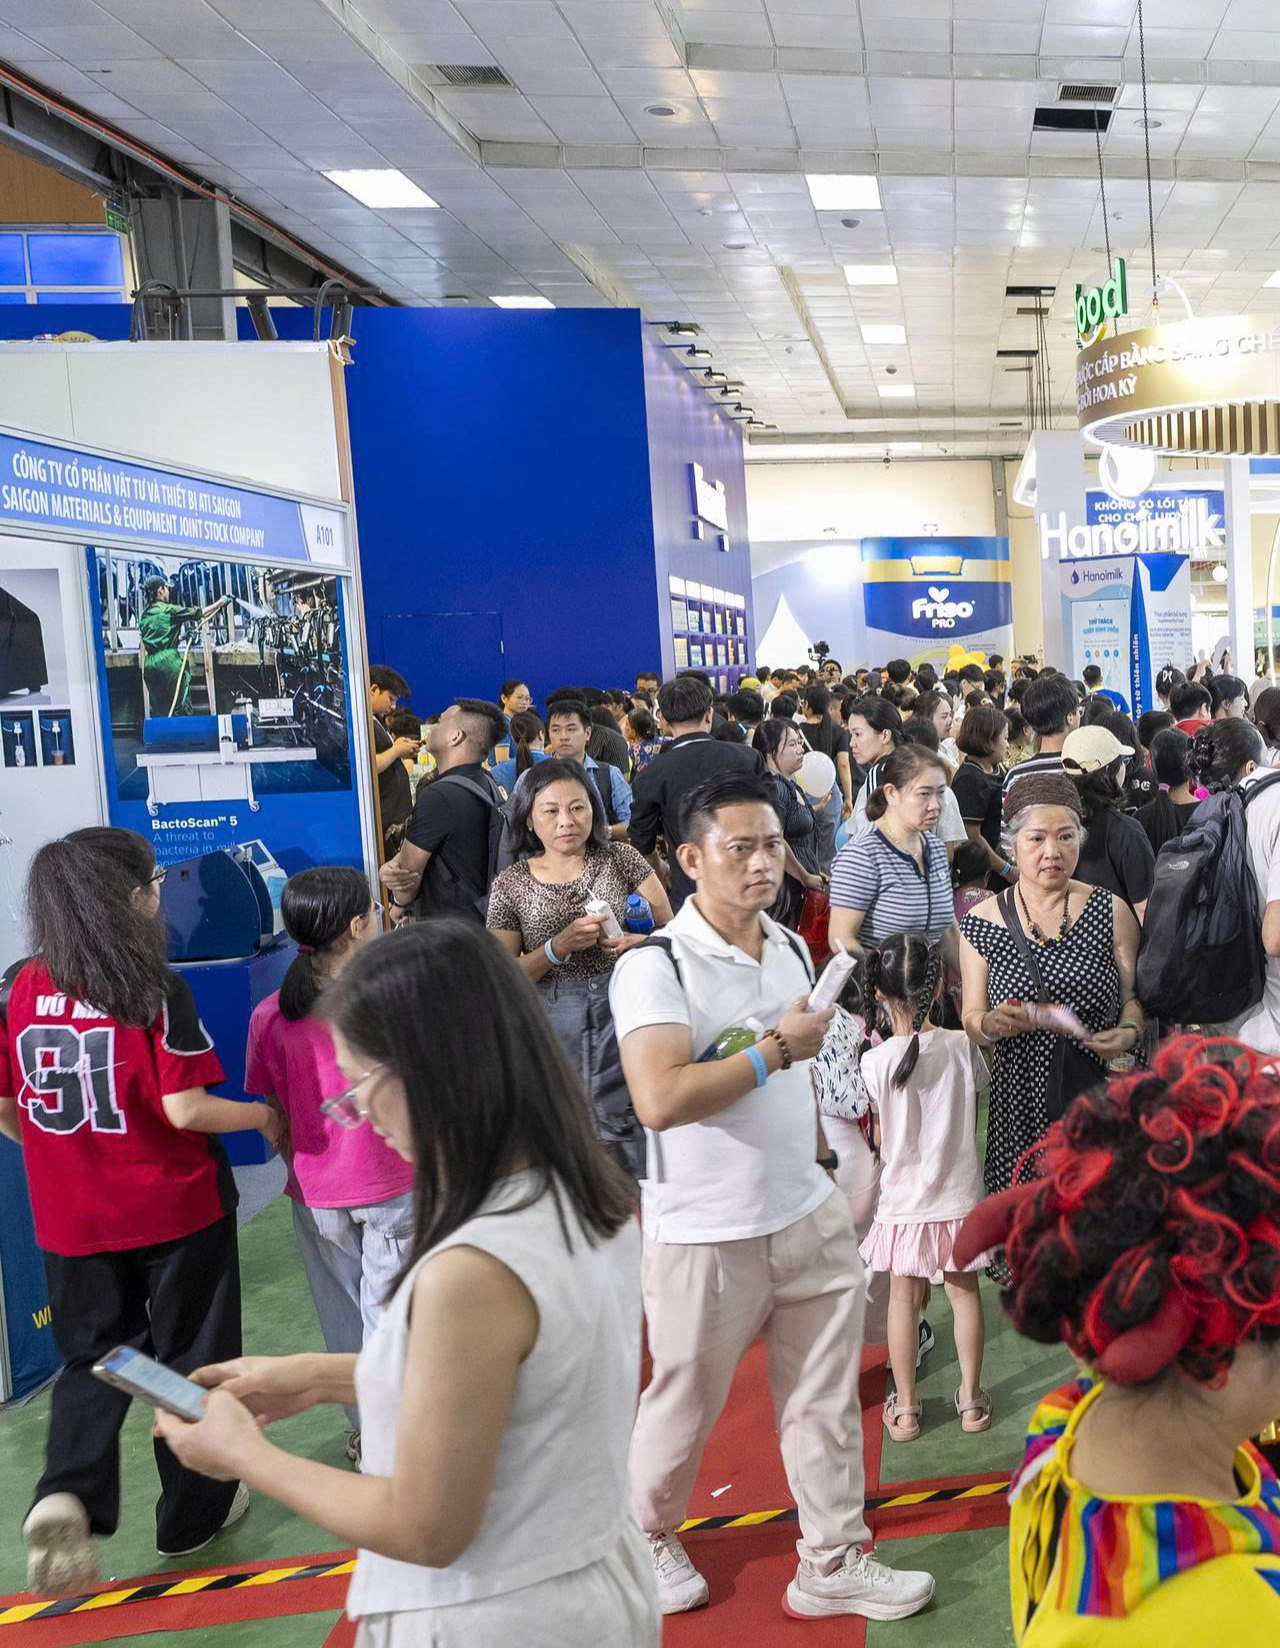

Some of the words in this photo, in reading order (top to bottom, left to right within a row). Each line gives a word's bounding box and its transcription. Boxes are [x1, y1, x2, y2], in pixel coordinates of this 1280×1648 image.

[1093, 381, 1118, 404] HOA
[1118, 373, 1138, 397] KỲ
[12, 450, 47, 483] CÔNG
[47, 460, 63, 485] TY
[65, 458, 80, 489] CỔ
[81, 464, 112, 495] PHẦN
[112, 471, 131, 503] VẬT
[132, 477, 147, 502] TƯ
[147, 481, 160, 502] VÀ
[160, 481, 187, 510] THIẾT
[187, 490, 198, 516] BỊ
[199, 493, 212, 514] ATI
[212, 497, 242, 519] SAIGON
[1095, 498, 1137, 512] KHÔNG
[1139, 497, 1155, 511] CÓ
[1157, 496, 1176, 509] LỐI
[2, 484, 50, 516] SAIGON
[51, 493, 112, 525] MATERIALS
[113, 504, 122, 527] &
[123, 506, 178, 536] EQUIPMENT
[179, 515, 203, 540] JOINT
[203, 521, 230, 544] STOCK
[229, 524, 265, 549] COMPANY
[1098, 513, 1121, 523] CHO
[316, 524, 335, 547] A101
[1040, 497, 1226, 560] Hanoimilk
[1083, 568, 1123, 582] Hanoimilk
[912, 597, 974, 619] Friso
[931, 618, 956, 629] PRO
[229, 815, 238, 827] 5
[153, 833, 162, 843] A
[166, 831, 200, 842] threat
[203, 831, 215, 841] to
[155, 844, 200, 856] bacteria
[203, 844, 213, 854] in
[36, 992, 68, 1017] VŨ
[16, 1023, 128, 1135] 91
